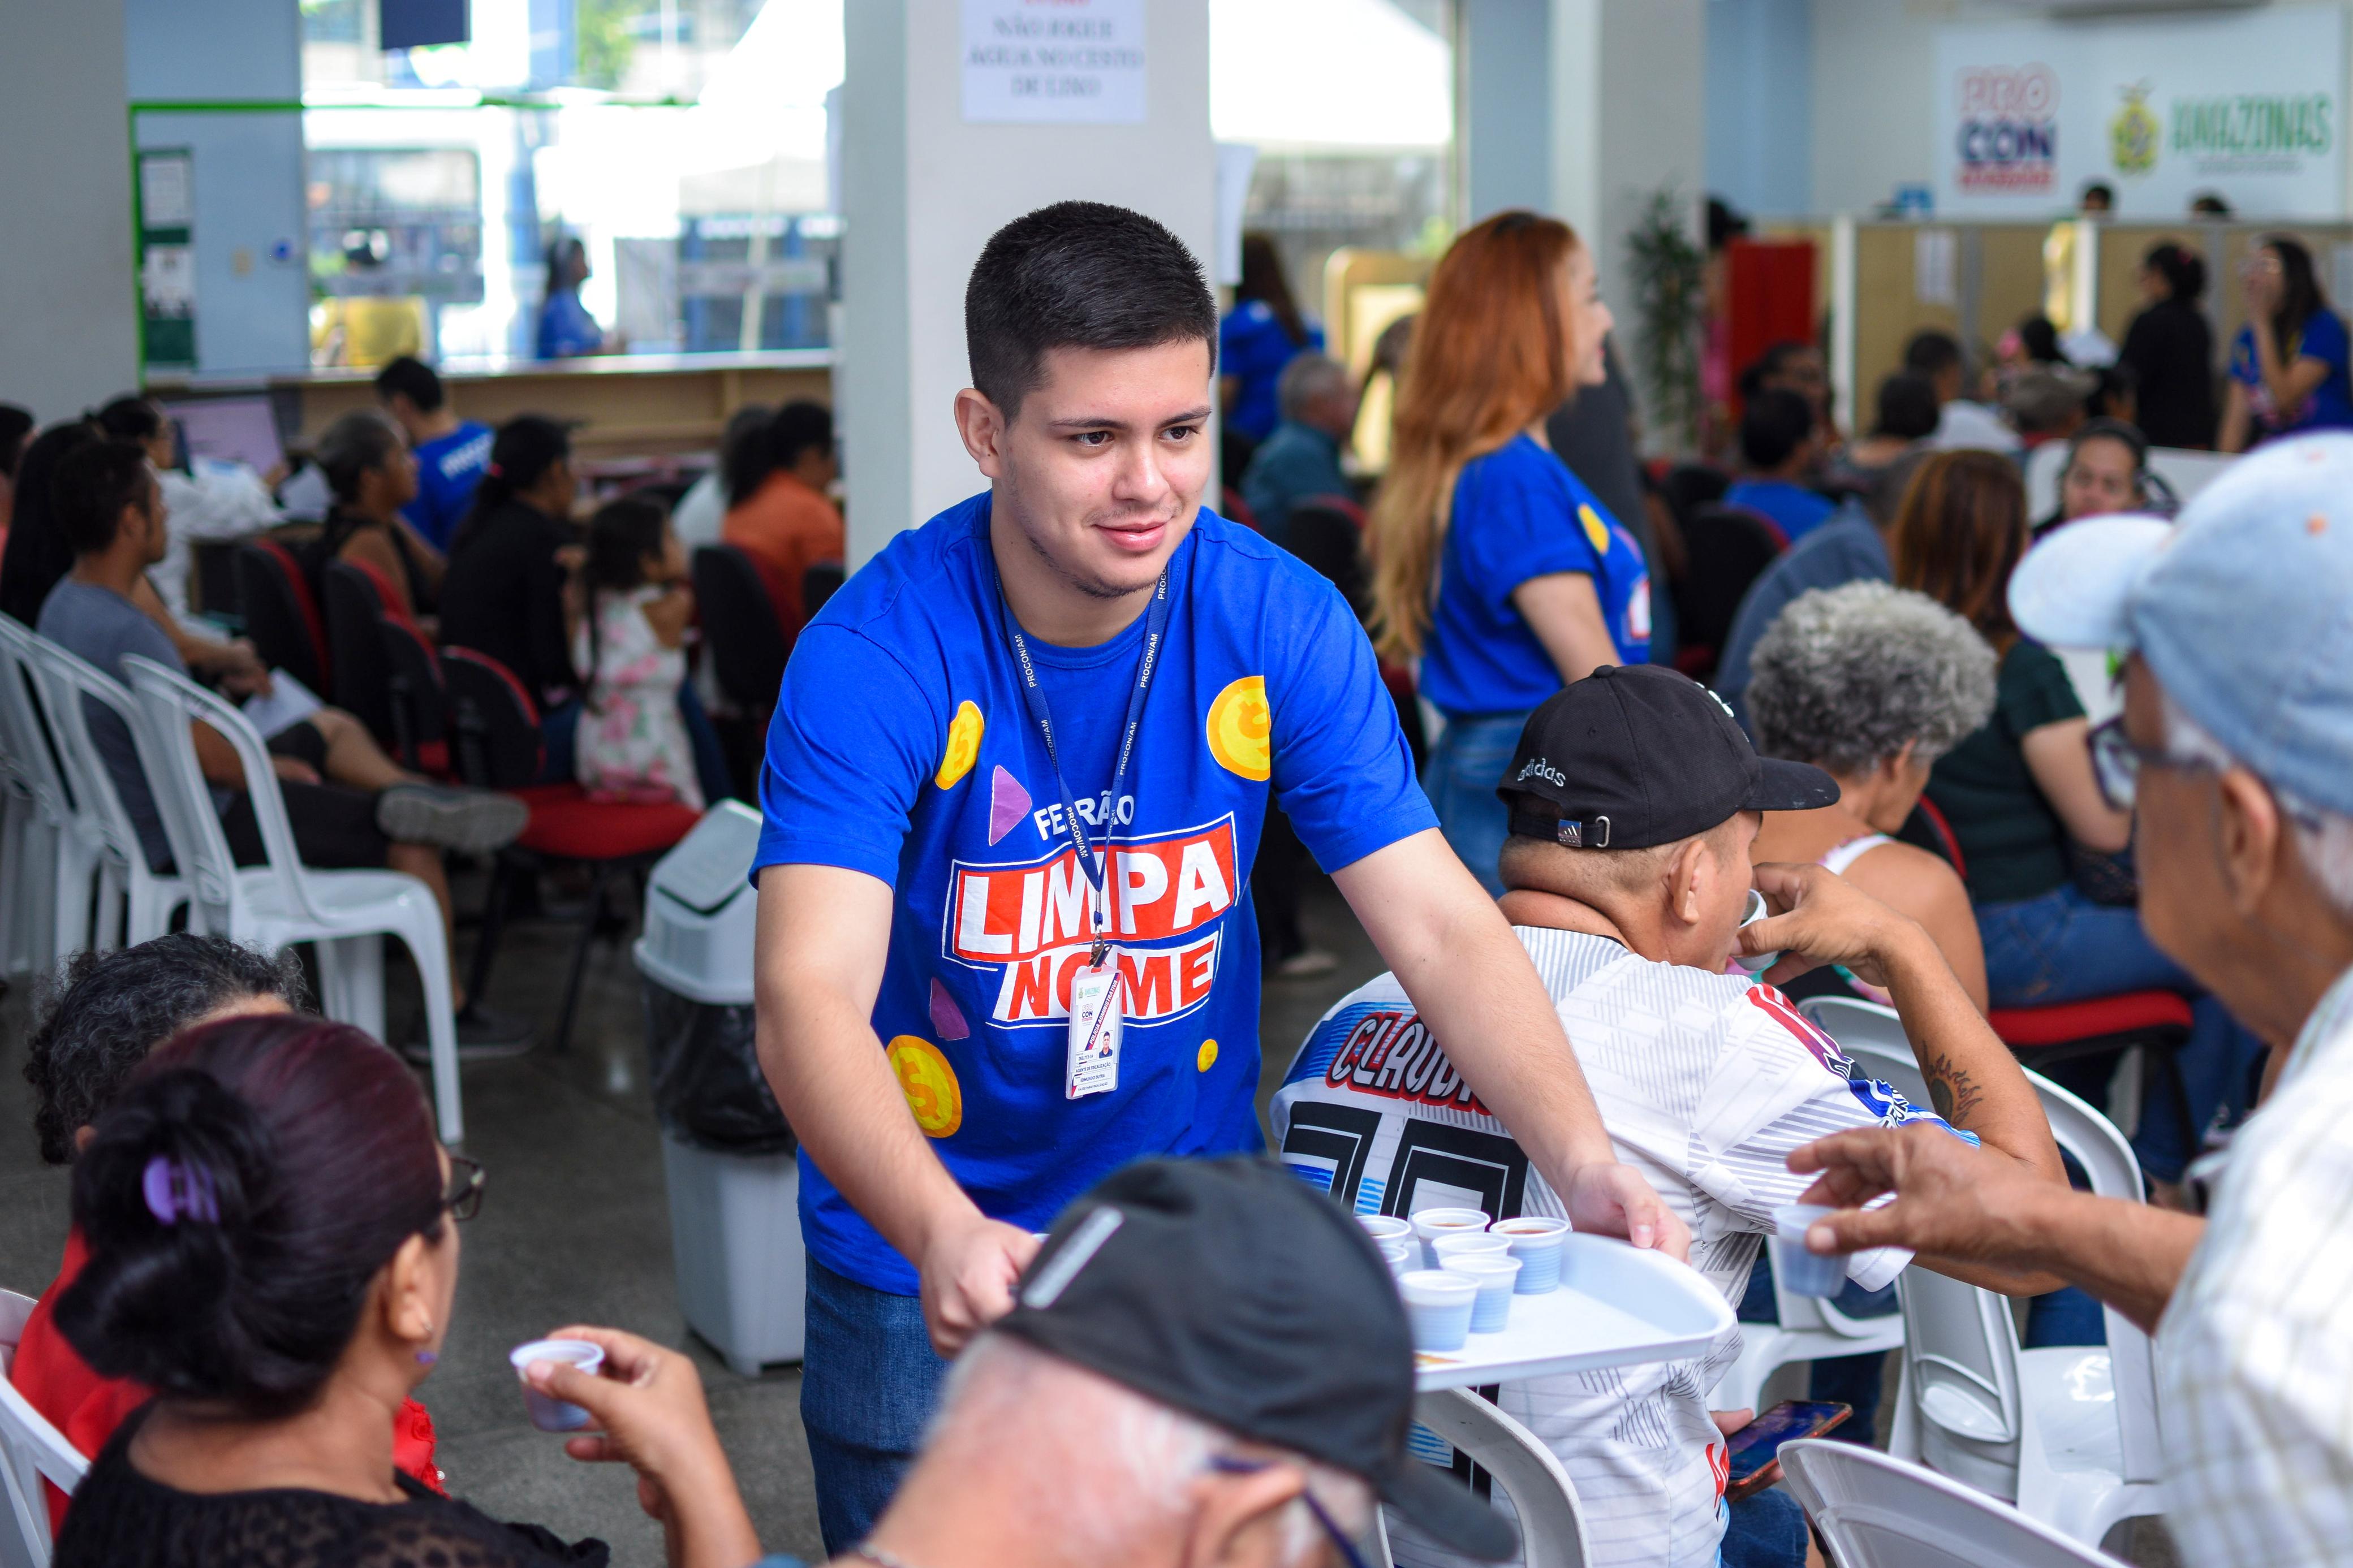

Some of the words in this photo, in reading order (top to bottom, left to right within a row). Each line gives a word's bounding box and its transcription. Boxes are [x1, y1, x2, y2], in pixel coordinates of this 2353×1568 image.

[1959, 118, 2057, 163] CON
[1014, 634, 1037, 688] PROCON/AM
[1140, 633, 1158, 688] PROCON/AM
[1119, 722, 1137, 776] PROCON/AM
[1517, 758, 1566, 787] adidas
[1065, 806, 1089, 858] PROCON/AM
[958, 840, 1231, 954] LIMPA
[1097, 980, 1118, 1024] ADMINISTRATIVA
